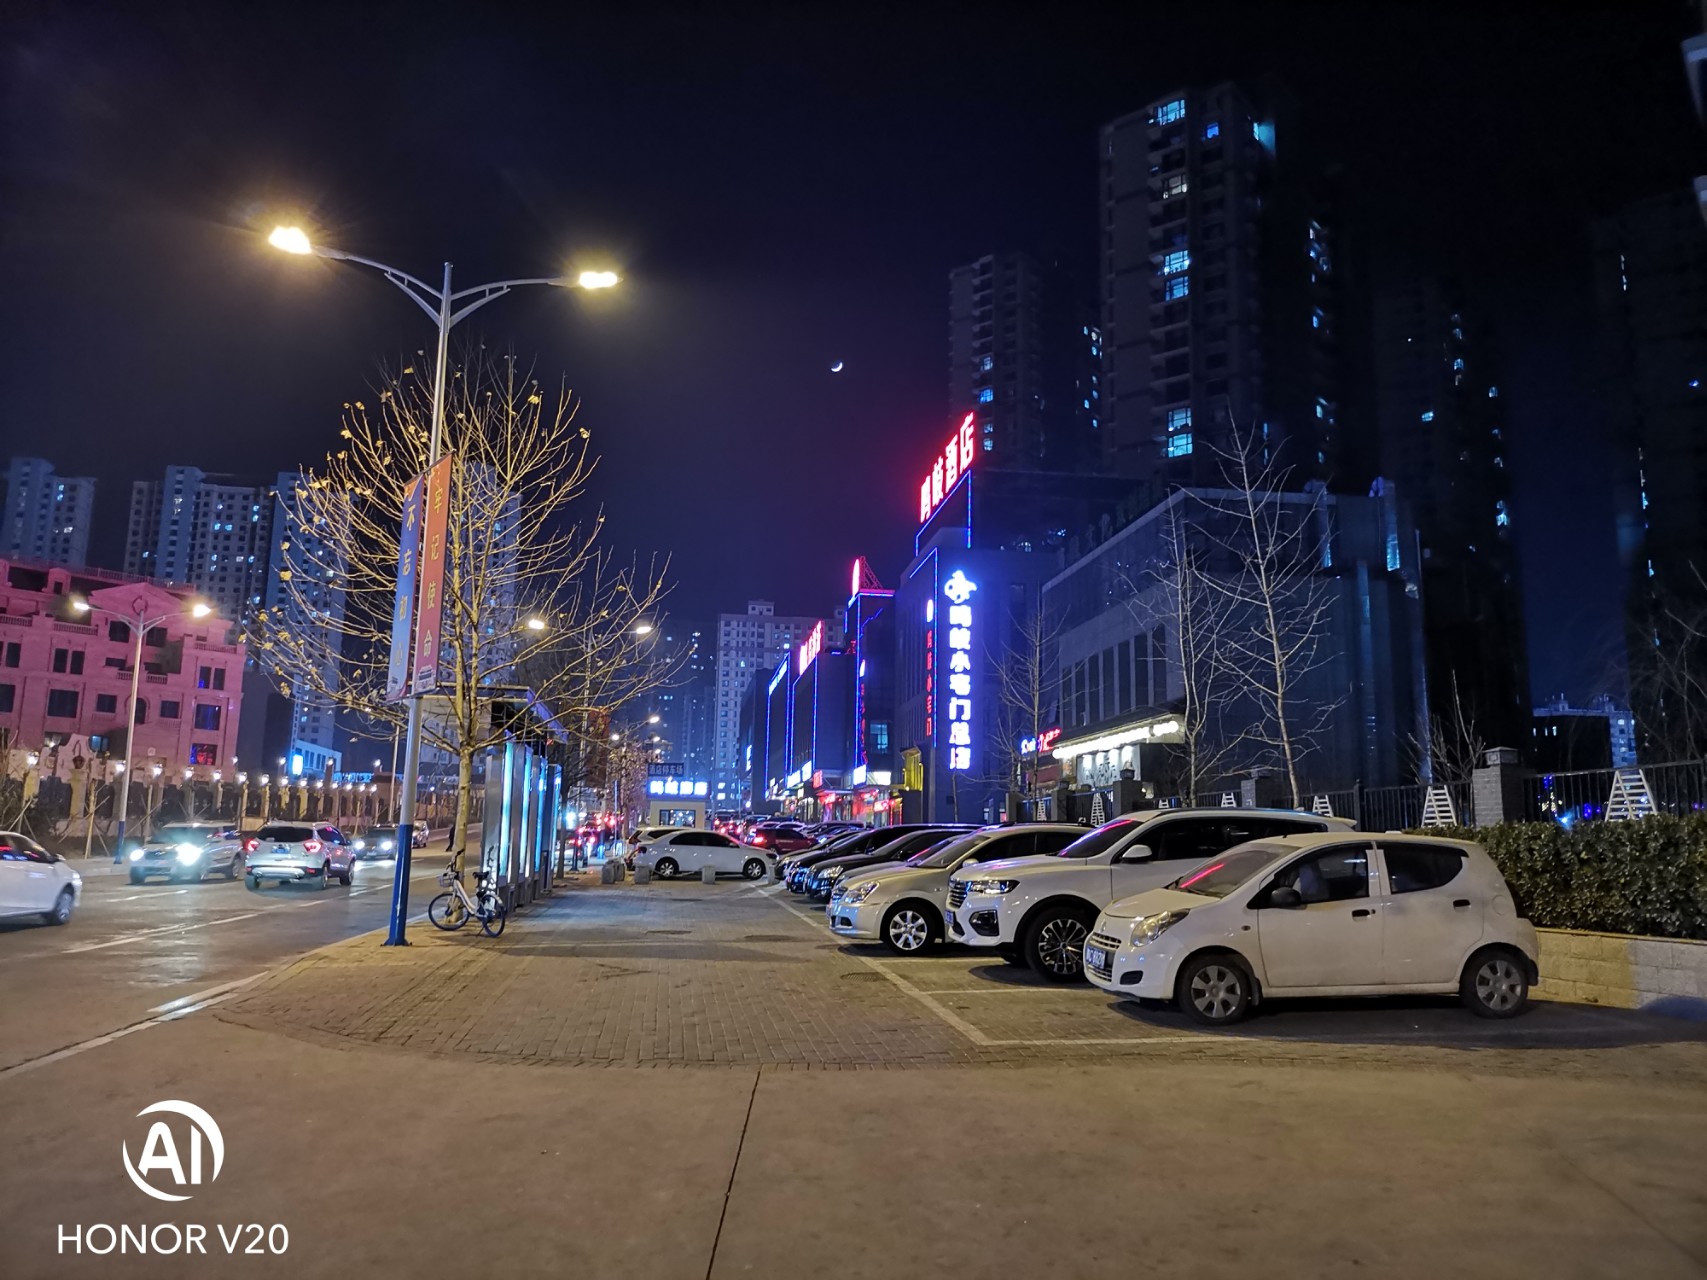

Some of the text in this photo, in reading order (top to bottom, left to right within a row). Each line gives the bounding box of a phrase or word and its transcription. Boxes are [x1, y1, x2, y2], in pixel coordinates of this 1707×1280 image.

[393, 502, 417, 667] 不忘初心
[422, 485, 445, 659] 牢记使命
